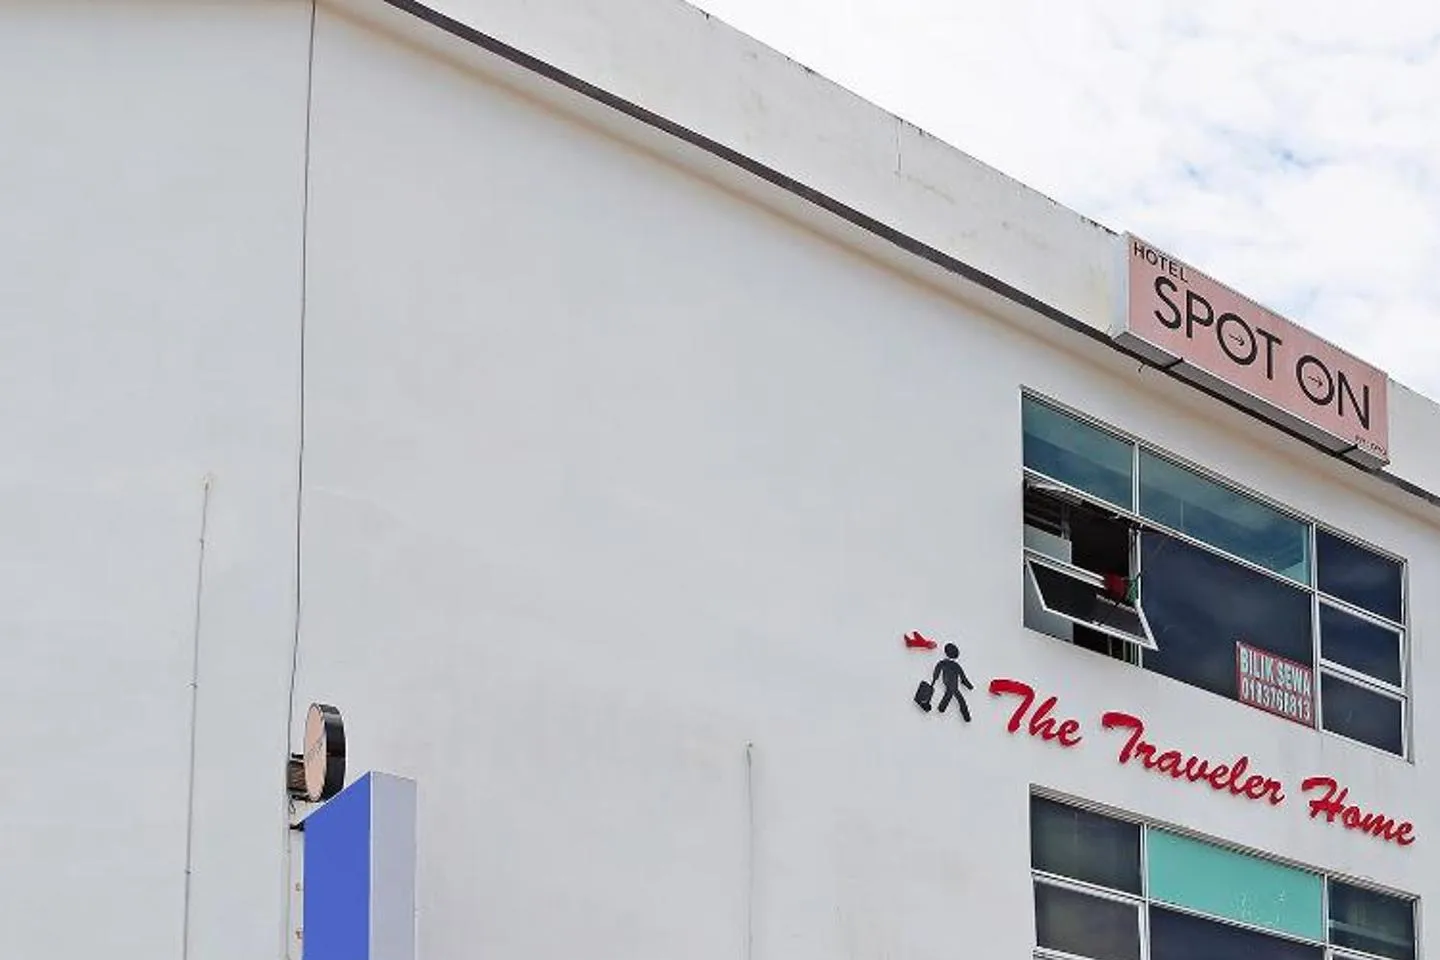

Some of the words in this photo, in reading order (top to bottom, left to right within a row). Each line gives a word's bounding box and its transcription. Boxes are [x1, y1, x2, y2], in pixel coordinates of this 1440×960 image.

[1133, 241, 1190, 283] HOTEL
[1153, 275, 1283, 381] SPOT
[1295, 354, 1370, 431] ON
[1240, 647, 1275, 682] BILIK
[988, 678, 1083, 748] The
[1101, 711, 1285, 806] Traveler
[1301, 776, 1416, 846] Home
